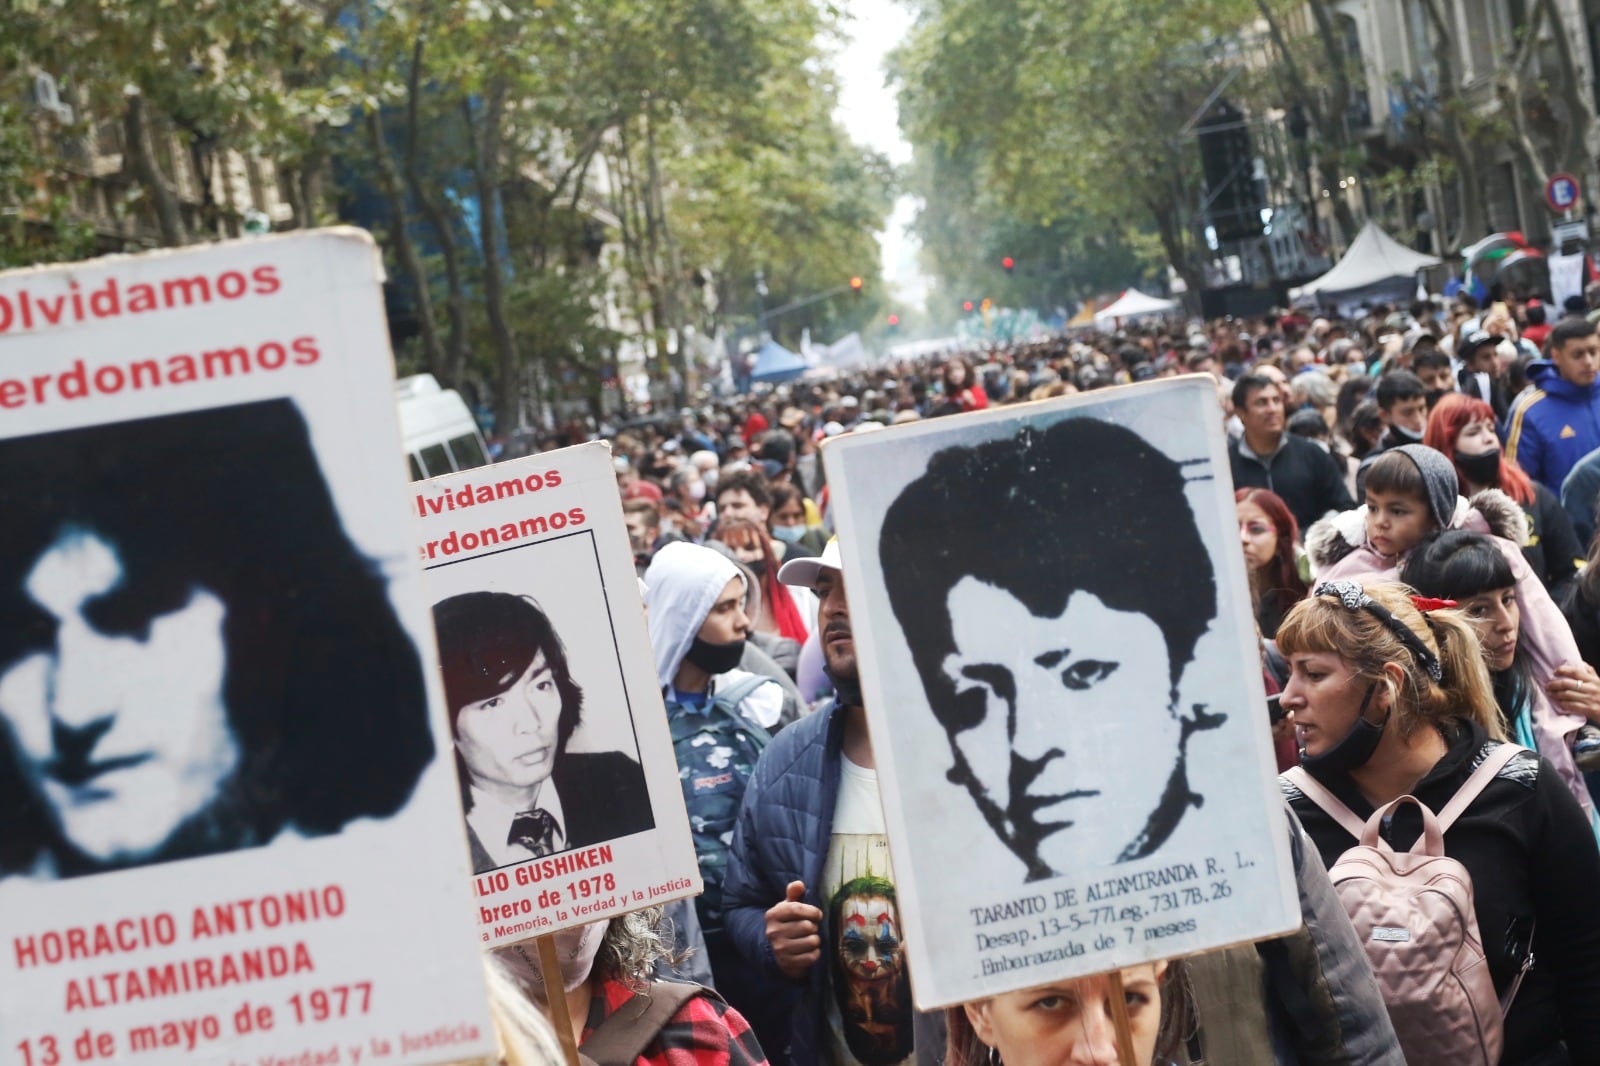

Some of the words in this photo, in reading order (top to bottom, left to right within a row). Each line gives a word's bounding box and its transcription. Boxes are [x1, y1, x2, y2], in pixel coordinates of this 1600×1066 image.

[1553, 180, 1572, 205] E
[414, 469, 562, 517] lvidamos
[475, 872, 509, 896] LIO
[515, 845, 613, 886] GUSHIKEN
[970, 895, 1047, 926] TARANTO
[1054, 888, 1079, 909] DE
[1086, 863, 1198, 903] ALTAMIRANDA
[1205, 857, 1225, 876] R.
[1235, 851, 1255, 870] L.
[478, 898, 532, 925] brero
[538, 889, 561, 909] de
[567, 872, 617, 901] 1978
[494, 915, 553, 938] Memoria,
[556, 909, 568, 922] la
[571, 896, 617, 917] Verdad
[620, 893, 629, 906] y
[632, 888, 645, 901] la
[649, 877, 692, 899] Justicia
[14, 913, 177, 969] HORACIO
[192, 884, 346, 940] ANTONIO
[1094, 933, 1116, 951] de
[1123, 926, 1136, 945] 7
[1143, 918, 1198, 942] meses
[66, 941, 315, 1012] ALTAMIRANDA
[17, 1034, 60, 1066] 13
[74, 1028, 114, 1062] de
[129, 1015, 221, 1052] mayo
[234, 1002, 274, 1035] de
[289, 981, 373, 1024] 1977
[347, 1045, 362, 1065] y
[370, 1036, 393, 1058] la
[400, 1022, 481, 1058] Justicia
